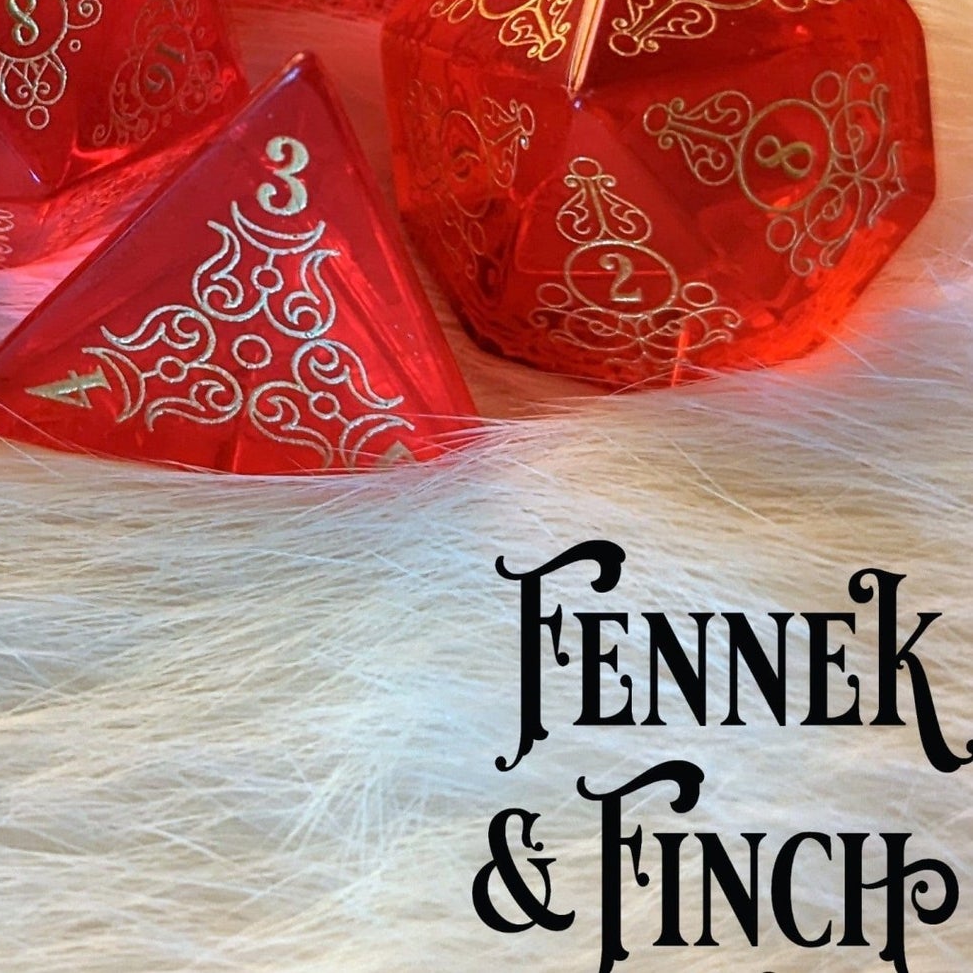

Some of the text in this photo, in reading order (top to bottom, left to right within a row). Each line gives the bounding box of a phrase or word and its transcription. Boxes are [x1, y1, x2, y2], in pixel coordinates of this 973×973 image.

[256, 136, 309, 216] 3
[755, 134, 813, 178] 8
[600, 252, 642, 303] 2
[25, 367, 114, 410] 4
